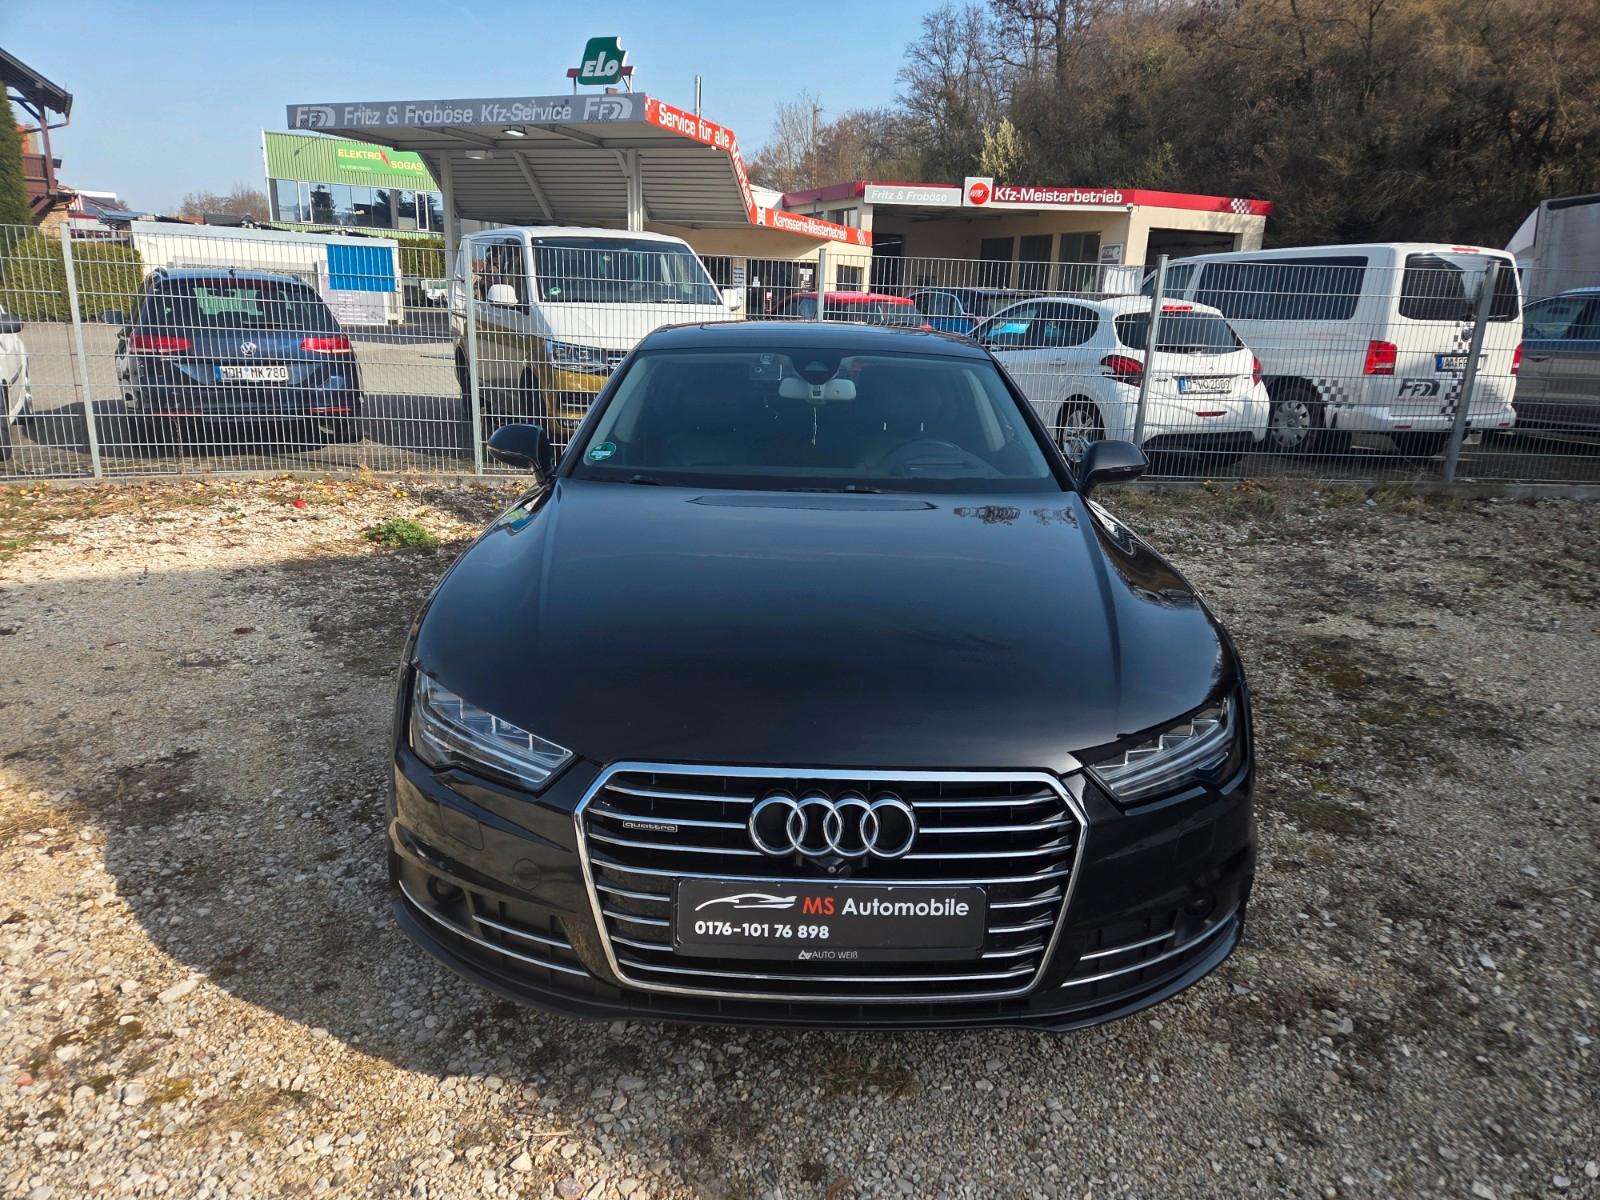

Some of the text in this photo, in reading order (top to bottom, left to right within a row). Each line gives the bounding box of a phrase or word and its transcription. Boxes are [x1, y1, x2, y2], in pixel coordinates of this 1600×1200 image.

[343, 105, 380, 125] Fritz
[386, 106, 399, 125] &
[405, 105, 473, 124] Froböse
[481, 100, 572, 122] Kfz-Service
[338, 149, 382, 160] ELEKTRO
[658, 103, 753, 212] Service für alle Marken
[871, 190, 948, 202] Fritz & Froböse
[995, 187, 1123, 204] Kfz-Meisterbetrieb
[773, 211, 848, 241] Karosserie-Meisterbetrieb
[266, 367, 286, 379] 780
[625, 822, 676, 831] quattro
[802, 896, 970, 916] MS Automobile
[694, 921, 830, 939] 0176-101 76 898
[811, 950, 836, 960] AUTO
